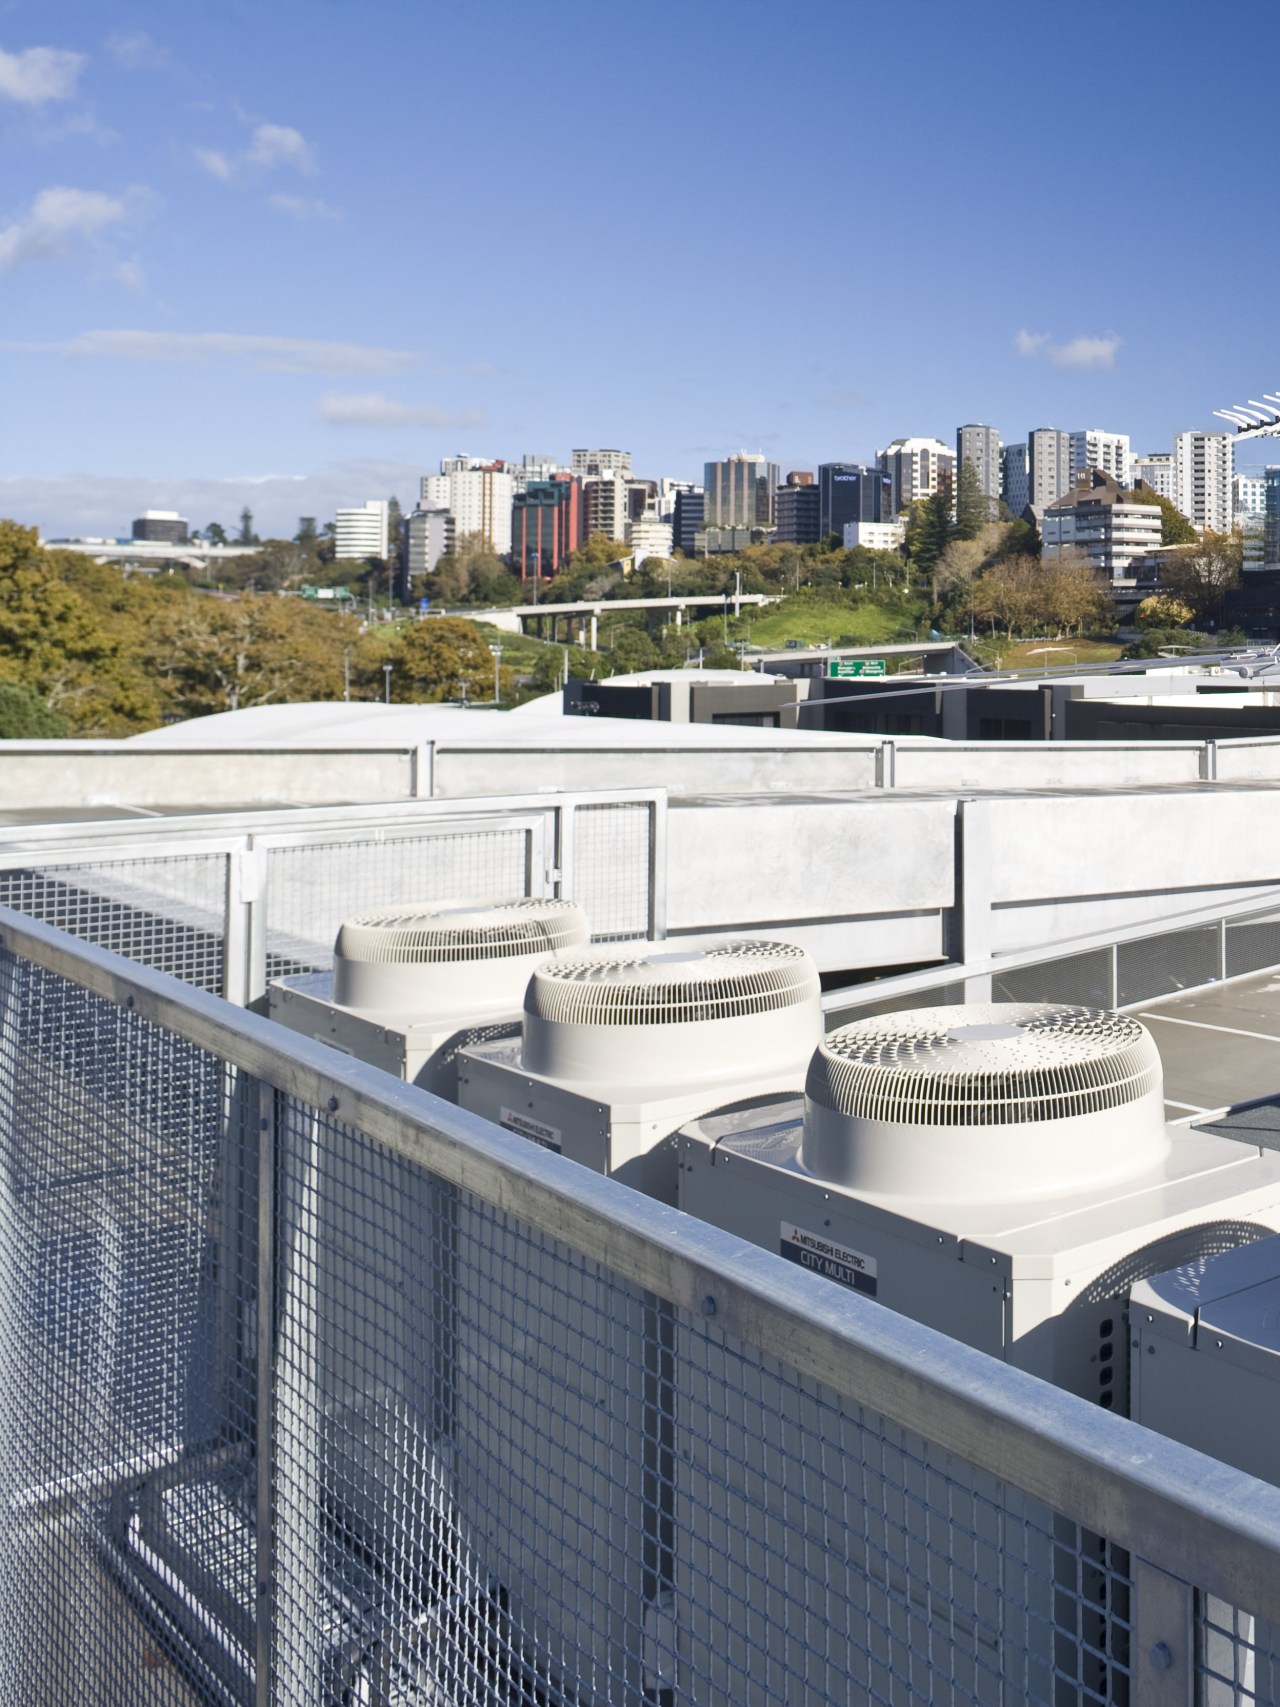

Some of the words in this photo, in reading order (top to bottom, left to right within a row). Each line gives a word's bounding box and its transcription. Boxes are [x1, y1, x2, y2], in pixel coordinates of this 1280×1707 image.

[800, 1234, 834, 1258] MITSUBISHI
[835, 1249, 865, 1270] ELECTRIC
[800, 1250, 825, 1271] CITY
[825, 1262, 855, 1285] MULTI
